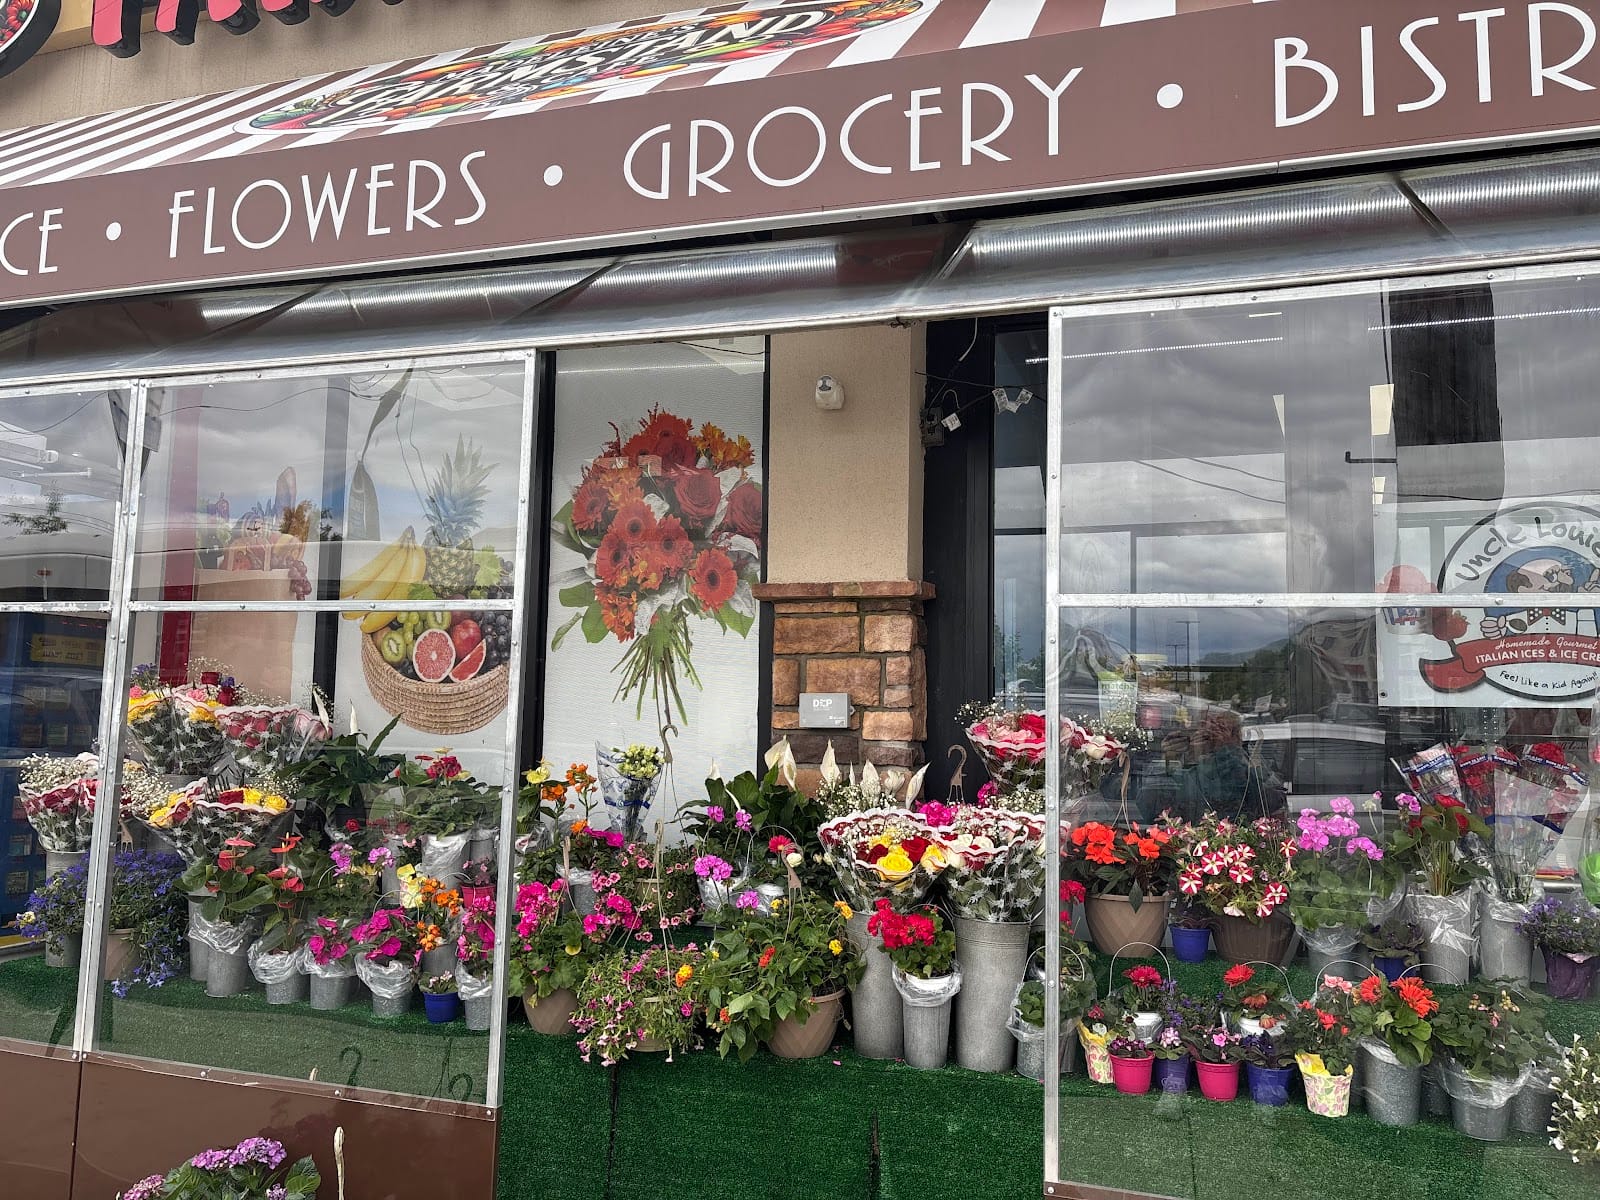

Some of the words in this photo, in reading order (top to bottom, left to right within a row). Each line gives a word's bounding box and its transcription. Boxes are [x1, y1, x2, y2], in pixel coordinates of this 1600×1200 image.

[308, 10, 831, 126] FARMSTAND
[0, 208, 63, 276] CE
[168, 150, 486, 258] FLOWERS
[623, 66, 1083, 200] GROCERY
[1455, 526, 1528, 581] Uncle
[1475, 650, 1518, 664] ITALIAN
[1521, 649, 1545, 658] ICES
[1548, 649, 1558, 658] &
[1560, 650, 1578, 659] ICE
[1495, 636, 1551, 650] Homemade
[1556, 636, 1598, 649] Gourmet
[1500, 670, 1519, 683] Feel
